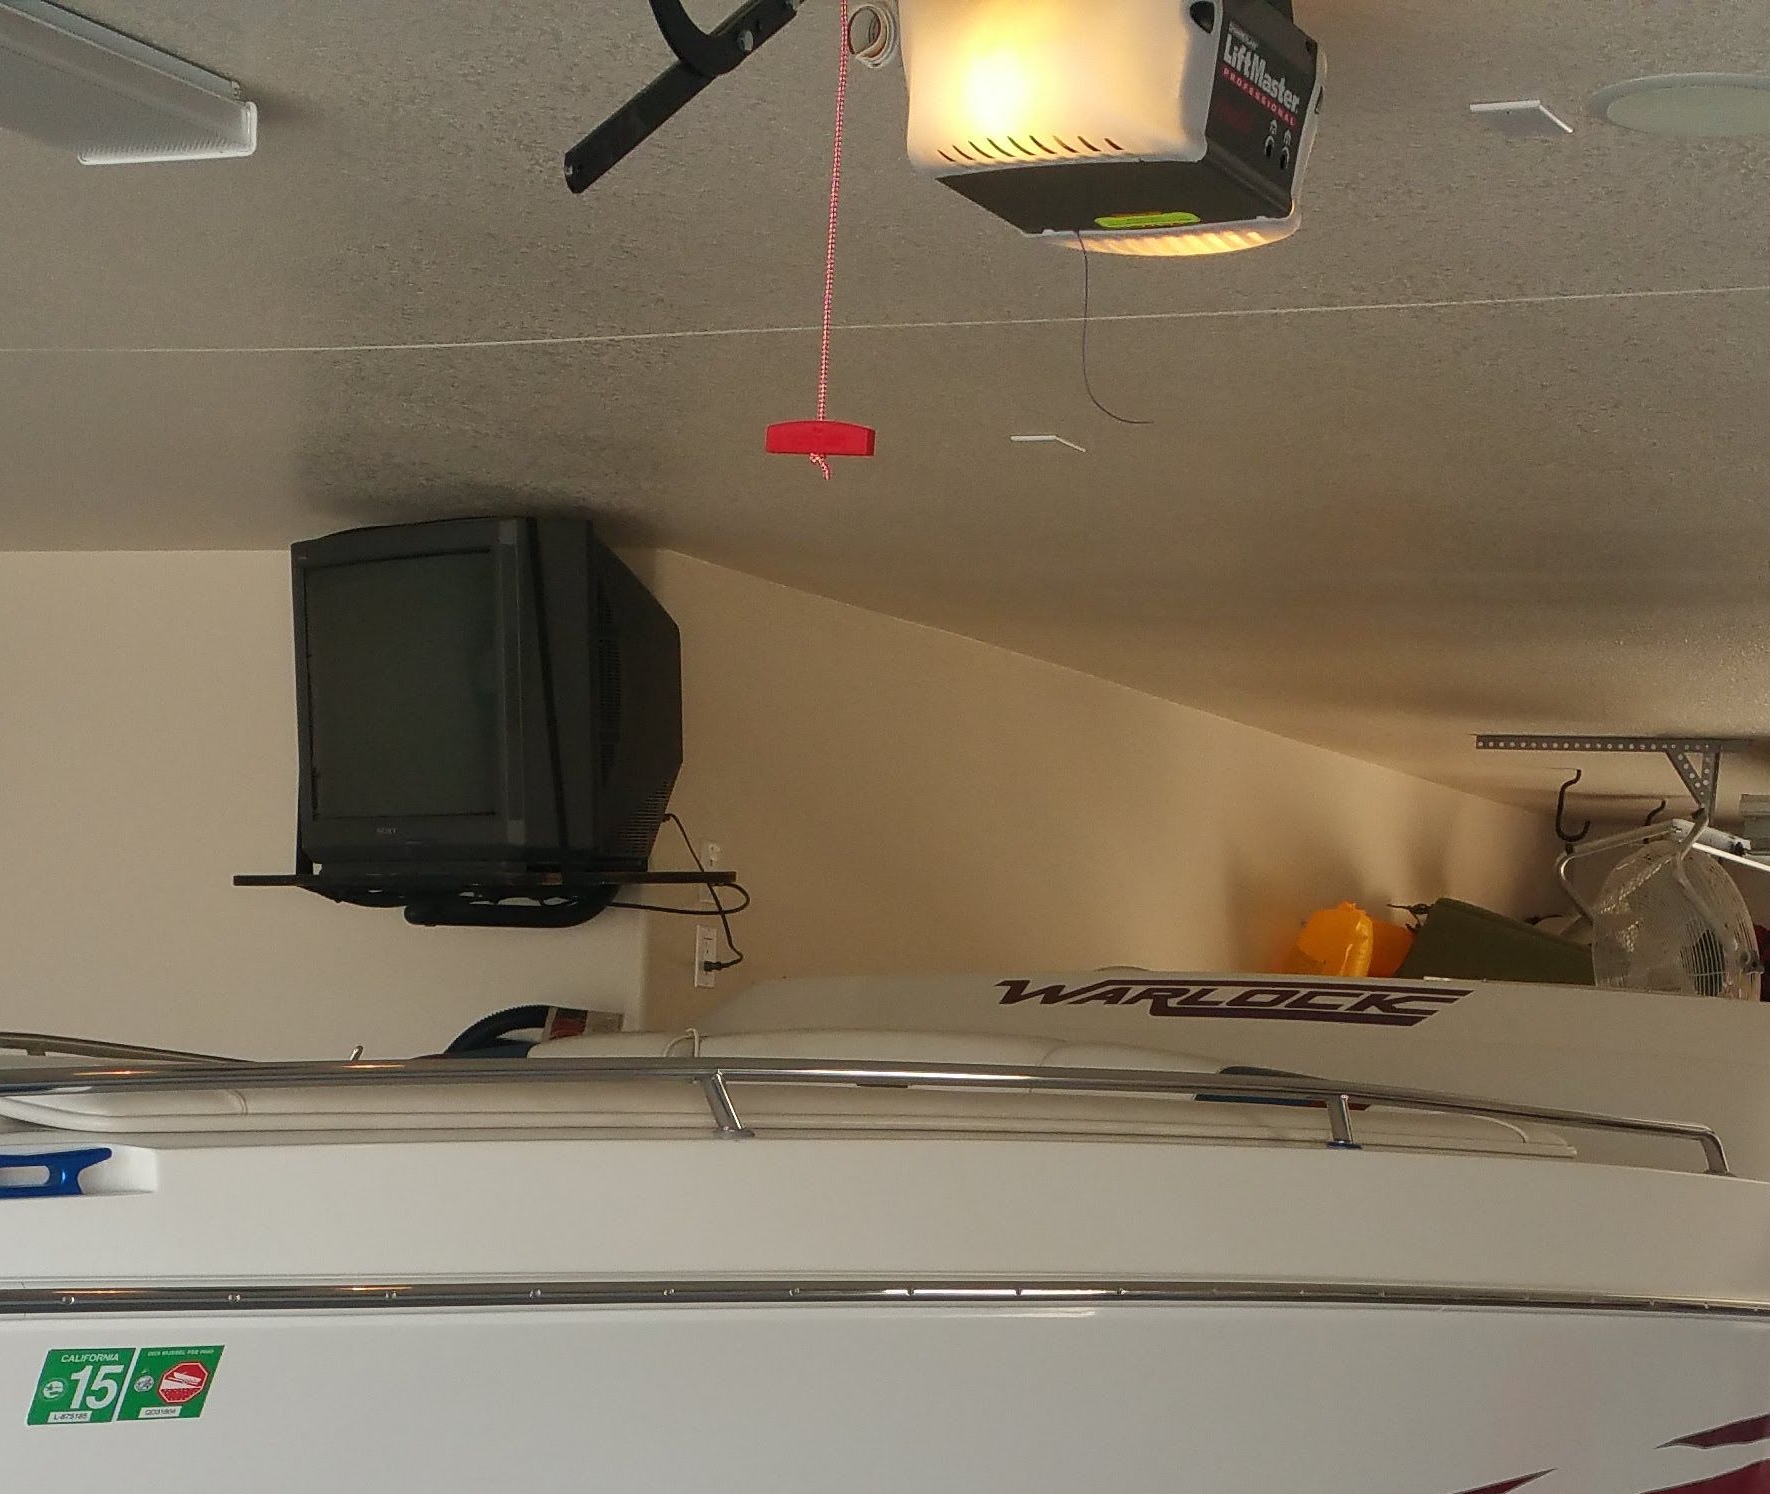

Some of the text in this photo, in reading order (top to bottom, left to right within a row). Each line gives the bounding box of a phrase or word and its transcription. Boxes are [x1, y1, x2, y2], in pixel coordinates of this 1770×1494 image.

[1222, 66, 1295, 126] PROFESSIONAL
[1223, 33, 1300, 114] LiftMaster
[995, 979, 1474, 1027] WARLOCK
[61, 1353, 120, 1363] CALIFORNIA
[70, 1365, 124, 1410] 15
